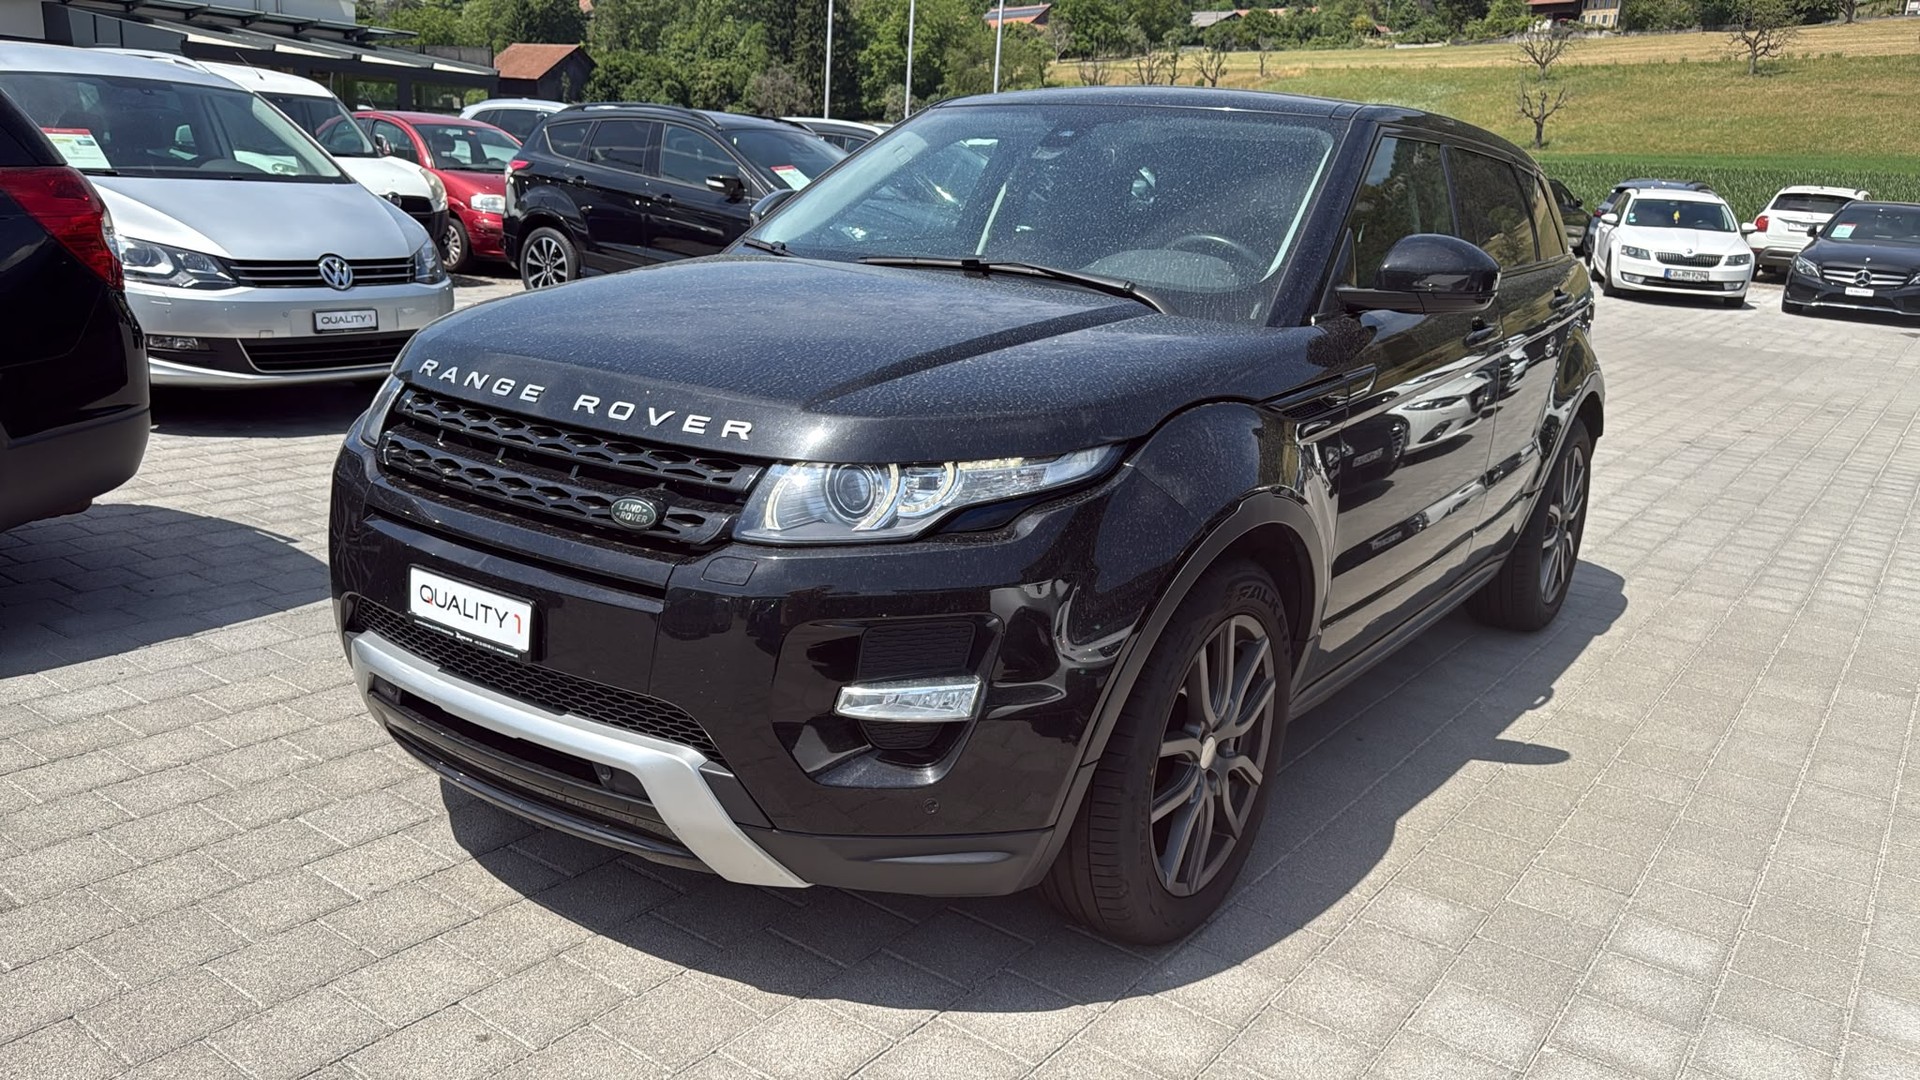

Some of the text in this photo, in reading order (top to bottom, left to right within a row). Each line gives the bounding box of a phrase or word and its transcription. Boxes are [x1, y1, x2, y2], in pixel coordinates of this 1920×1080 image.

[321, 314, 367, 325] QUALITY
[418, 359, 753, 441] RANGE ROVER
[619, 502, 642, 514] LAND
[619, 510, 648, 524] ROVER
[420, 584, 521, 635] QUALITY 1
